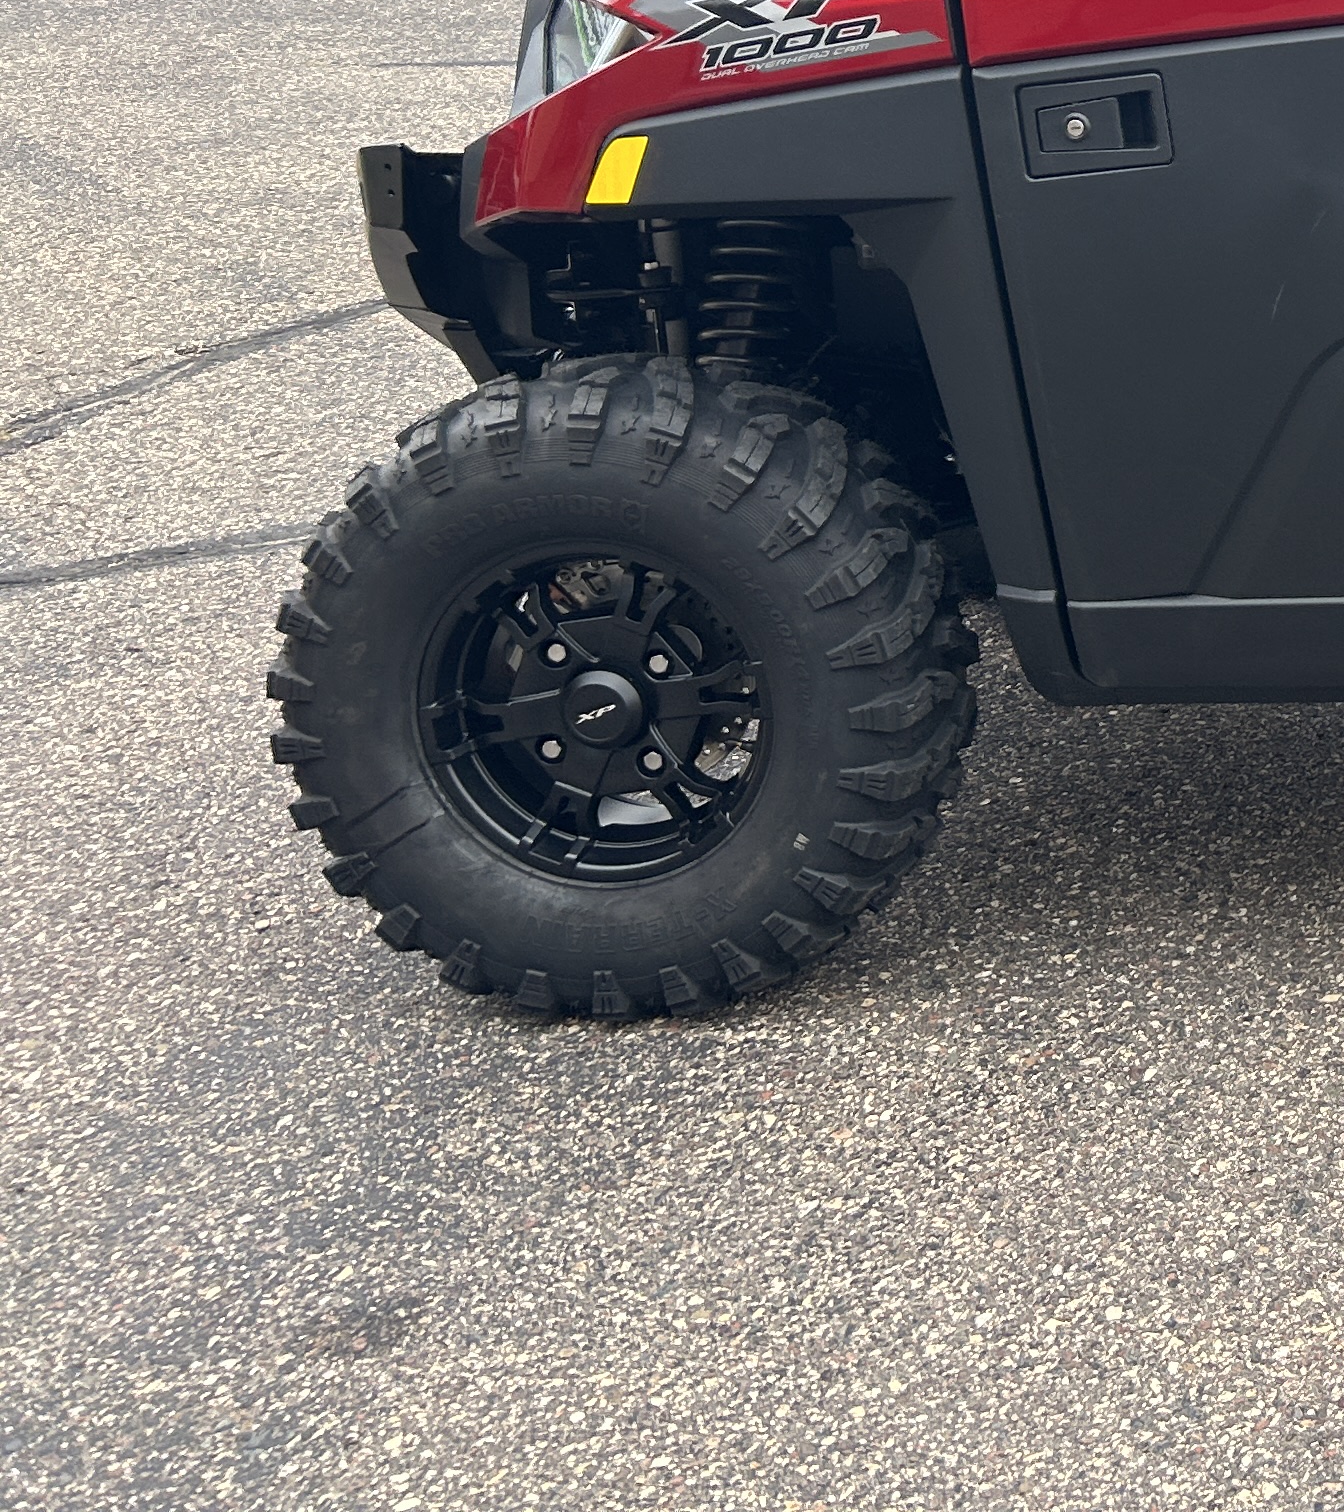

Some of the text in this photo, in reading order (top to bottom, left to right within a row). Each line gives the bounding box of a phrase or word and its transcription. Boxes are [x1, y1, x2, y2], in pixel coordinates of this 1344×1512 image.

[700, 15, 882, 72] 1000
[700, 42, 869, 81] DUAL OVERHEAD CAM
[575, 703, 617, 726] XP
